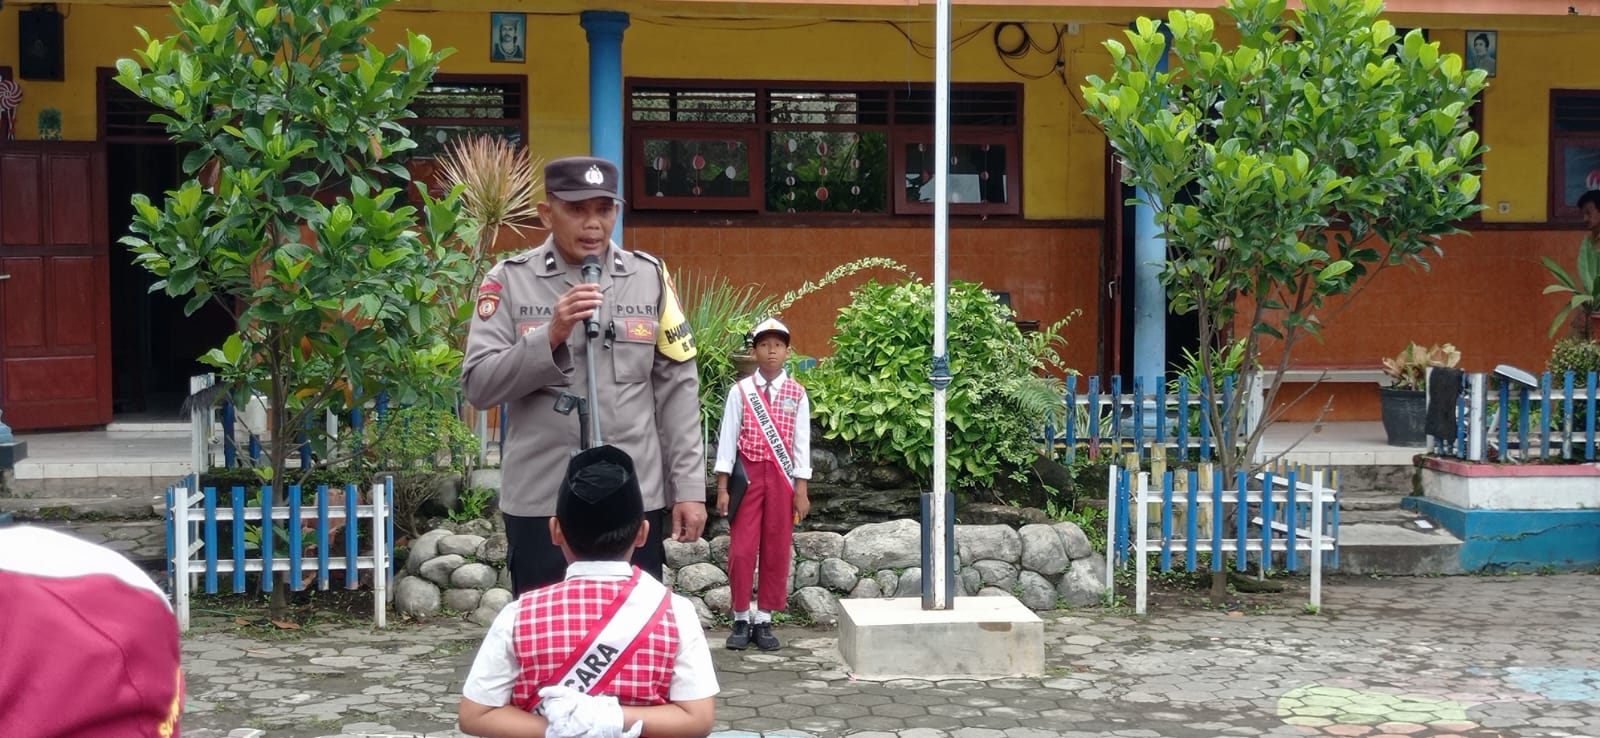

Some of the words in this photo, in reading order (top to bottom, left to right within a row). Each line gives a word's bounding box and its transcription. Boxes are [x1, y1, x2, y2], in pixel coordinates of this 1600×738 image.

[616, 304, 656, 316] POLRI
[748, 392, 769, 427] PEMBAWA
[764, 424, 780, 445] TEKS
